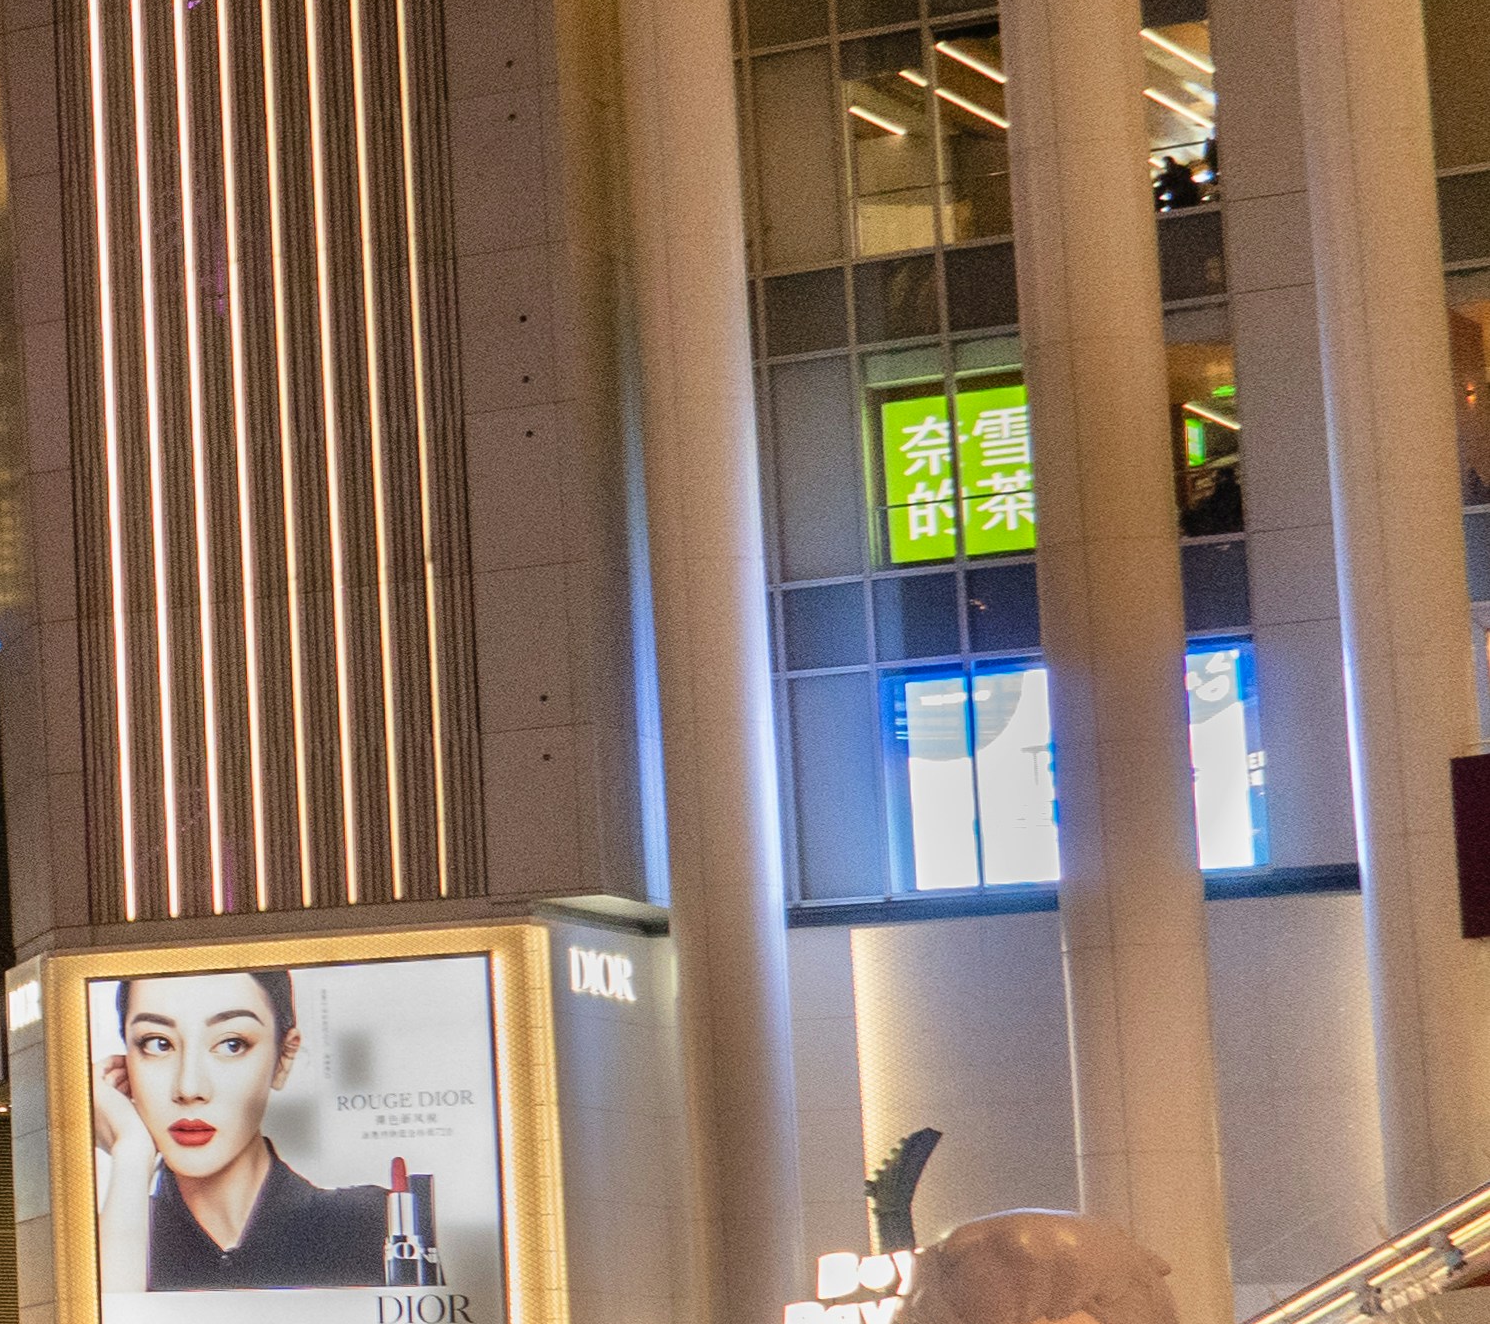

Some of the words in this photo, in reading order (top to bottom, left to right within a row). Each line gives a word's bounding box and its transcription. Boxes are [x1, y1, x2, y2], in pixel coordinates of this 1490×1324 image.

[899, 403, 1034, 479] 奈雪
[906, 472, 1037, 542] 的茶
[568, 945, 636, 1002] DIOR
[336, 1092, 413, 1112] ROUGE
[417, 1088, 475, 1108] DIOR
